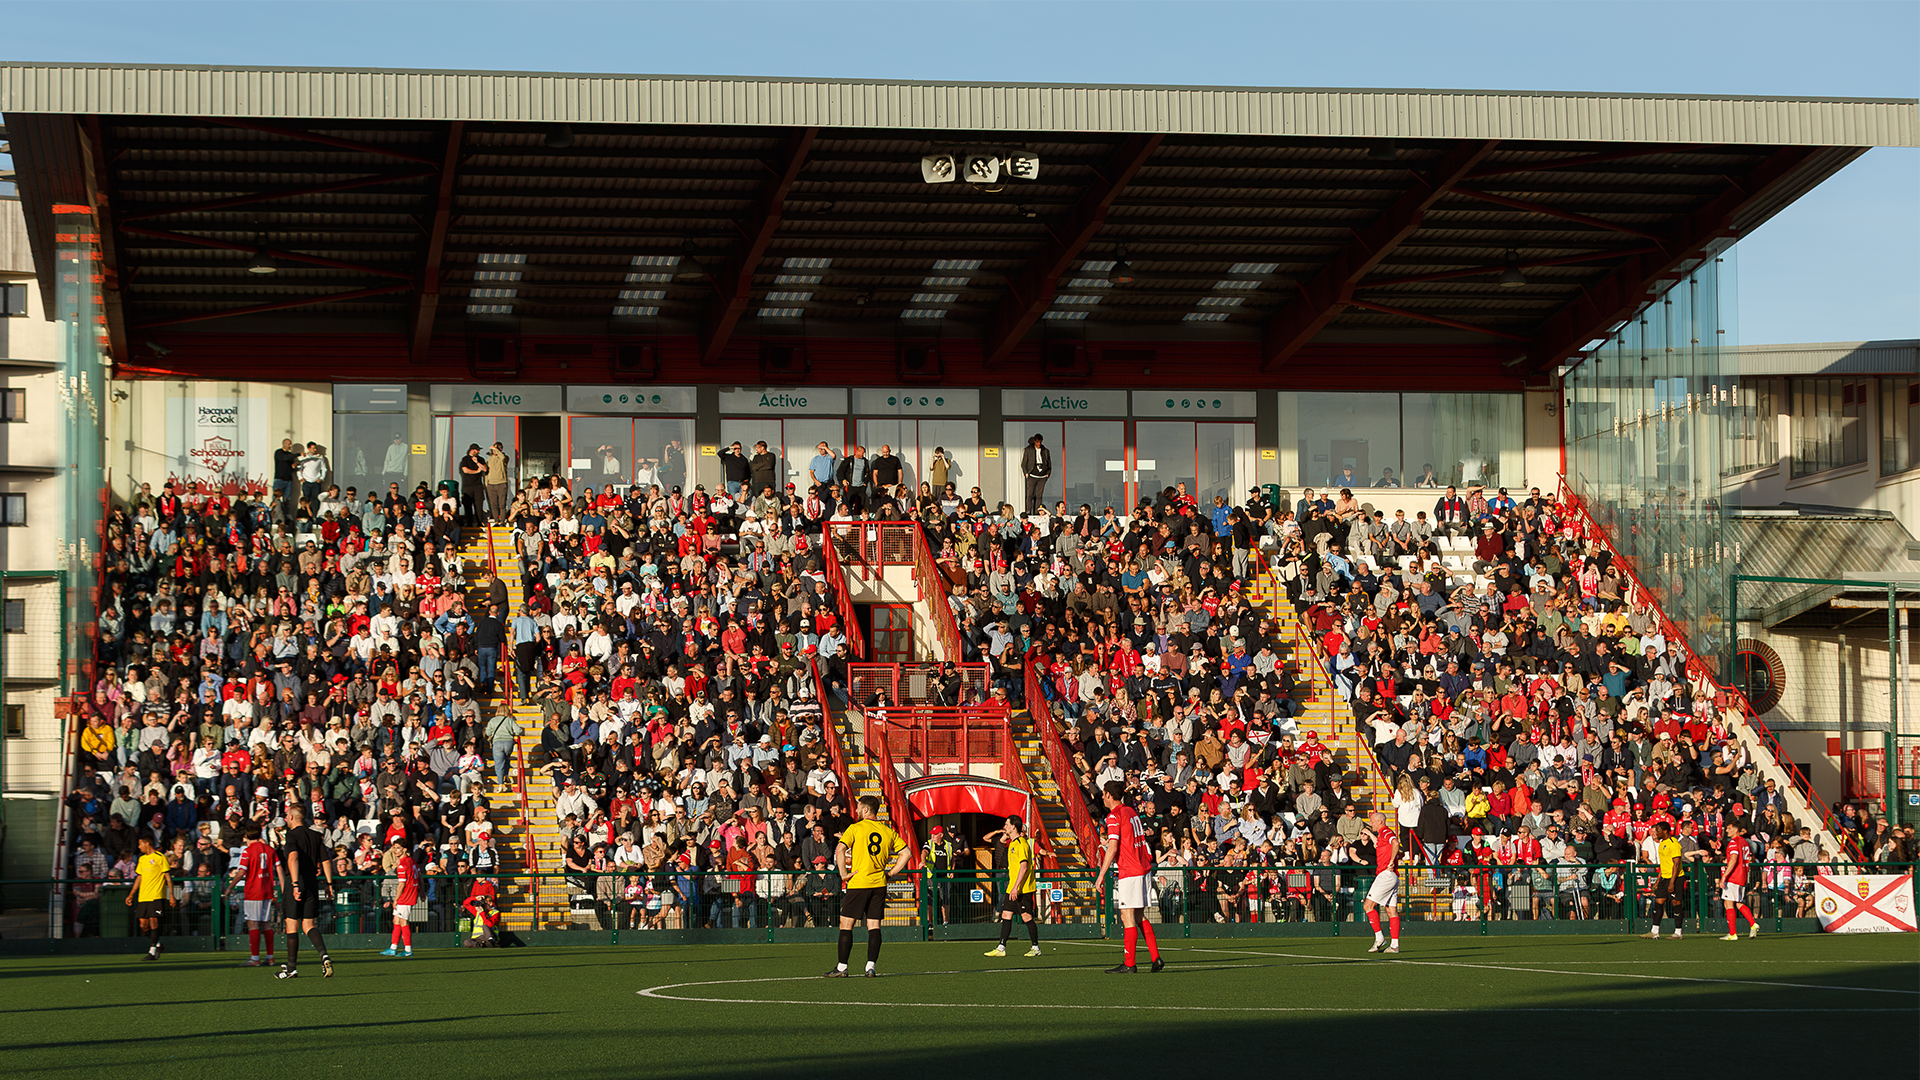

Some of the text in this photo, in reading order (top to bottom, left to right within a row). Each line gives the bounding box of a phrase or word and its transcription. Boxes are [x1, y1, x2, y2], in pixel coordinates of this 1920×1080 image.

[471, 391, 521, 405] Active
[759, 394, 808, 407] Active
[1040, 396, 1088, 410] Active
[198, 406, 238, 416] Hacquoil
[210, 415, 235, 423] Cook
[190, 449, 245, 457] SchoolZone
[1130, 816, 1144, 837] 10
[868, 832, 882, 856] 8
[1742, 846, 1749, 860] 12
